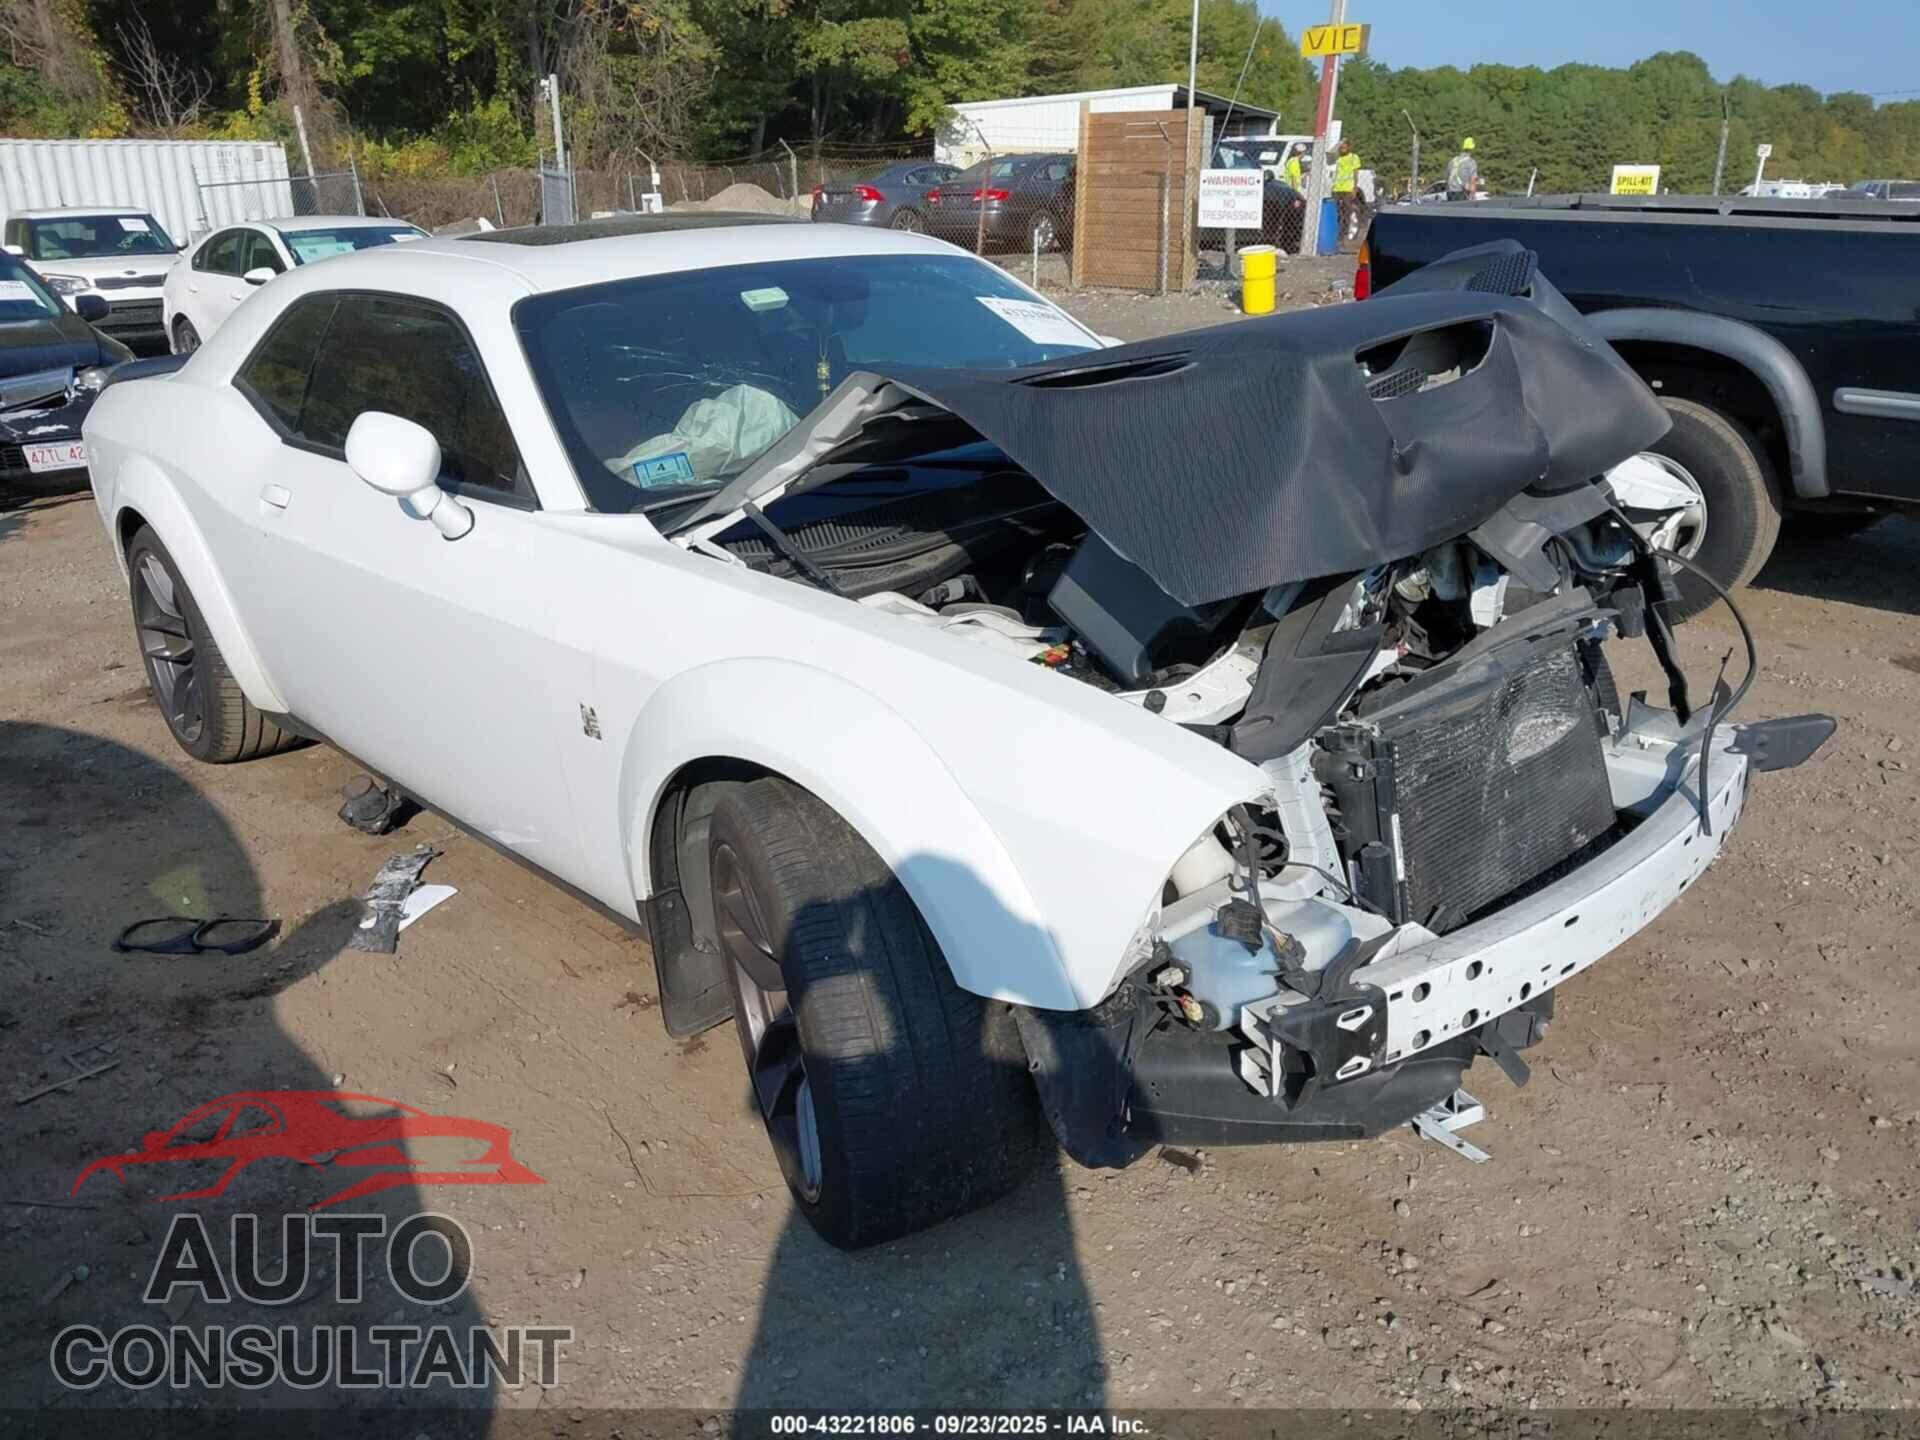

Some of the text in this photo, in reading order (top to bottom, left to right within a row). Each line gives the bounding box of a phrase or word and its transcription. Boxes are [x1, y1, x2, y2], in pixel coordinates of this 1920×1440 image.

[1207, 176, 1256, 186] WARNING
[1223, 199, 1236, 209] NO
[1202, 210, 1258, 221] TRESPASSING
